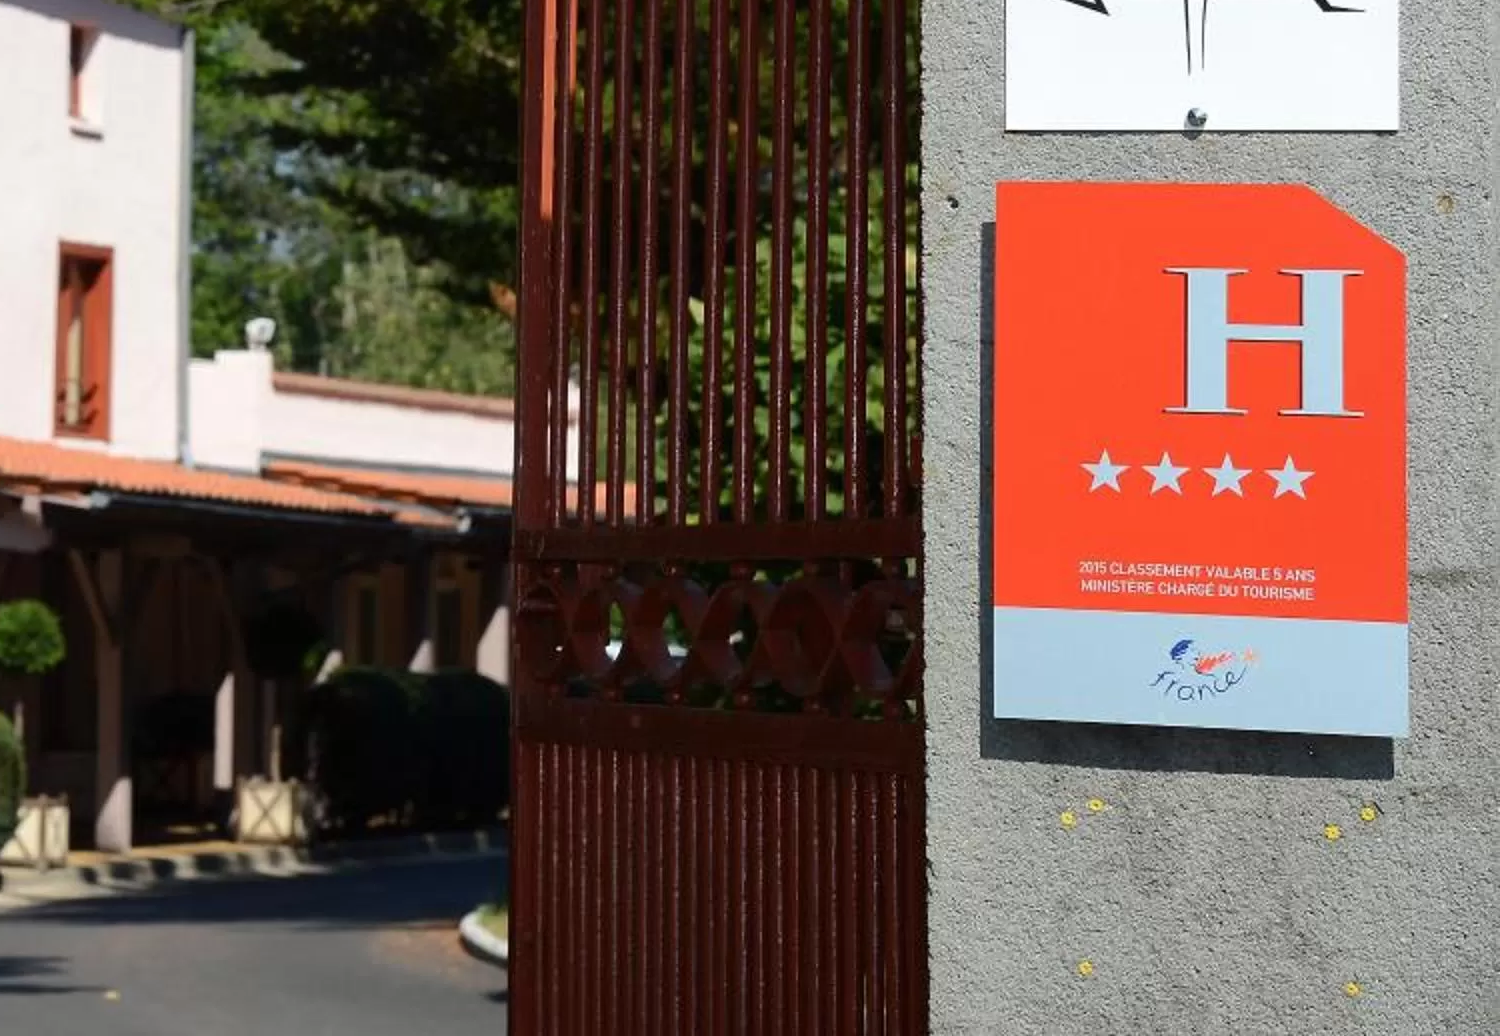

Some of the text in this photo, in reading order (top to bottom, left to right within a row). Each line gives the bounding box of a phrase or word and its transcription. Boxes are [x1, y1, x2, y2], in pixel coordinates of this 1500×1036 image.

[1162, 267, 1365, 418] H
[1079, 561, 1316, 582] 2015 CLASSEMENT VALABLE 5 ANS
[1081, 580, 1314, 600] MINISTÈRE CHARGÉ DU TOURISME
